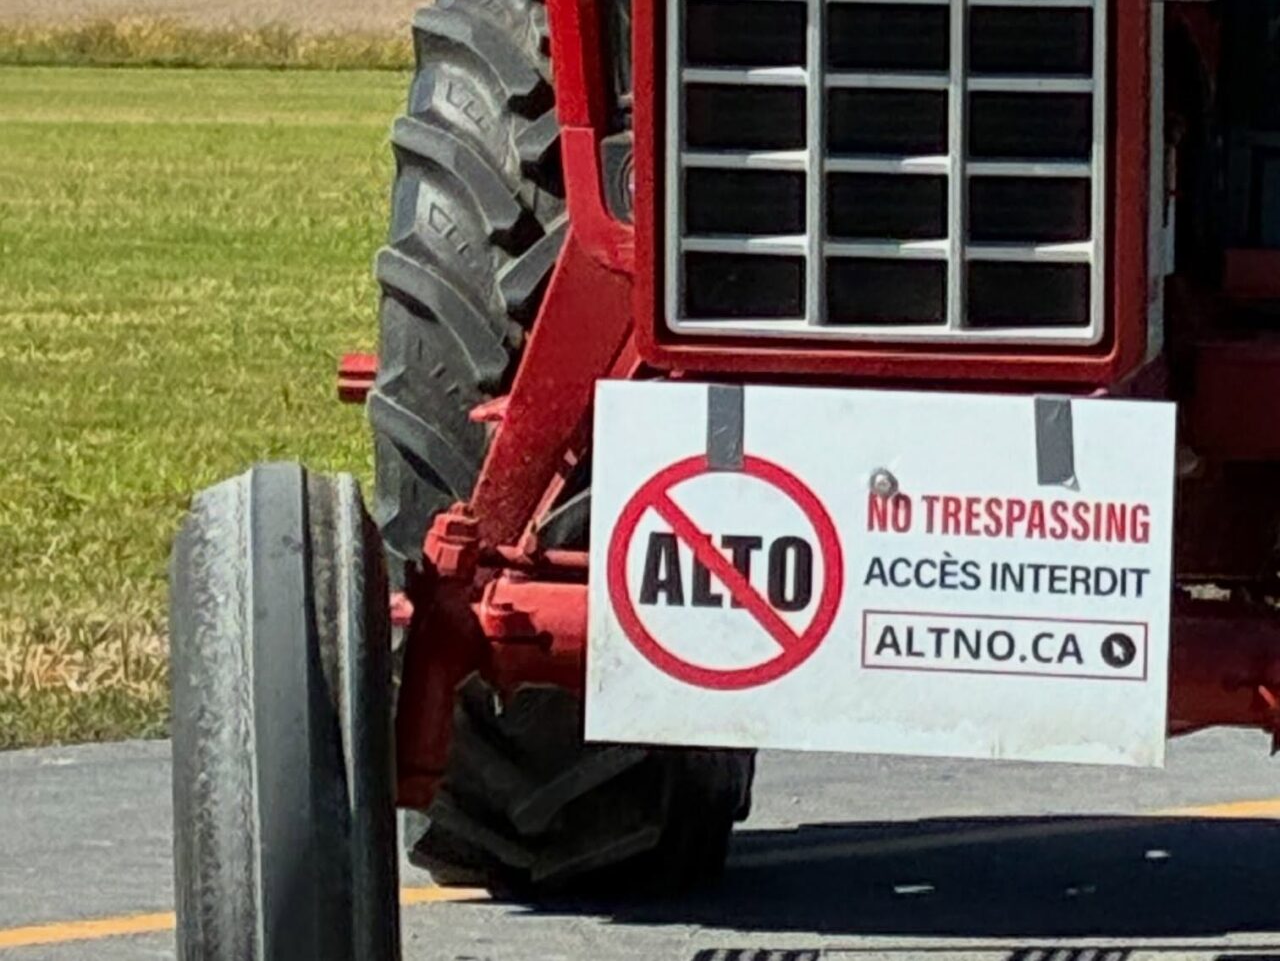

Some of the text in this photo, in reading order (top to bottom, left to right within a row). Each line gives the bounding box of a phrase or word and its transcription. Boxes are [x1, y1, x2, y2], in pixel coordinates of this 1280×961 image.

[867, 491, 1151, 544] NO TRESPASSING
[639, 531, 814, 612] ALTO
[864, 550, 1151, 597] ACCÈS INTERDIT
[875, 625, 1084, 665] ALTNO.CA
